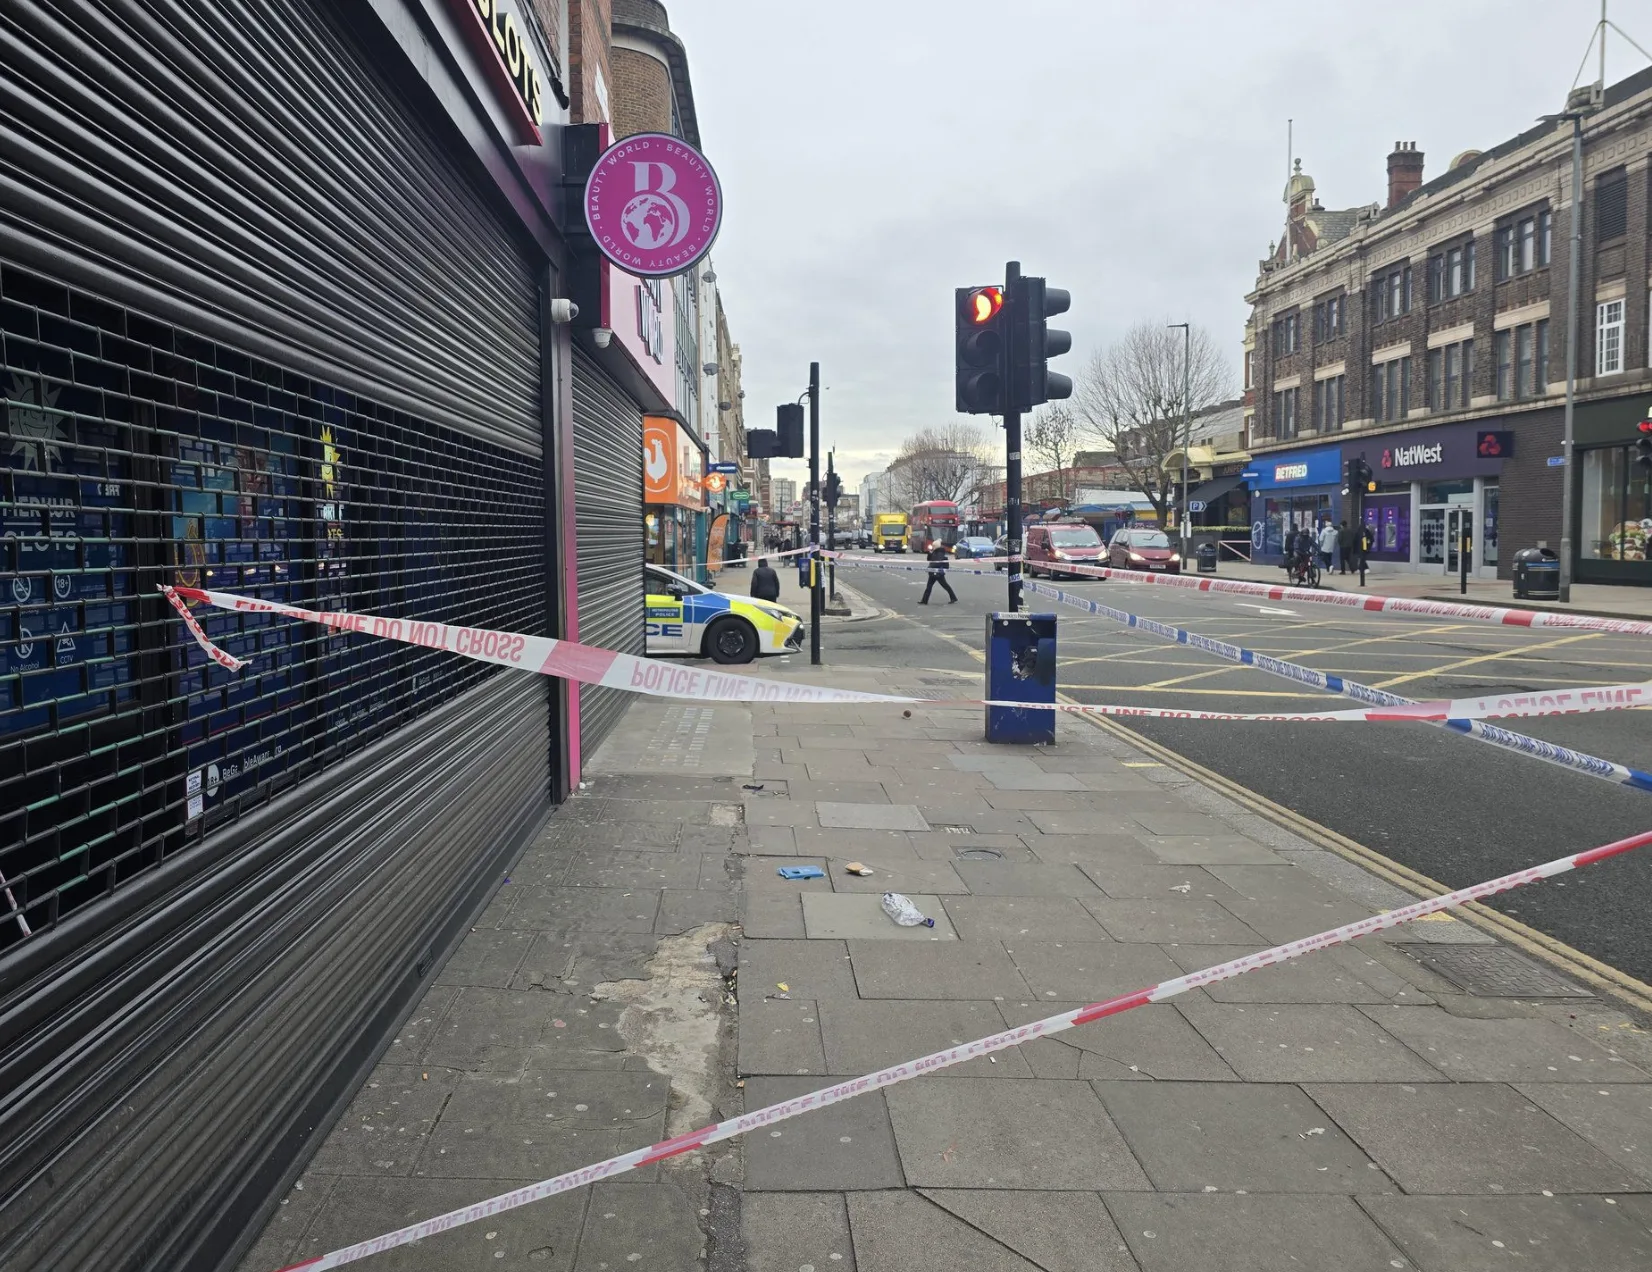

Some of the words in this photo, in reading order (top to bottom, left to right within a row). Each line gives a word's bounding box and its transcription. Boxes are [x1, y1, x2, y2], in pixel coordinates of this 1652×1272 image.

[592, 168, 607, 221] BEAUTY
[606, 140, 650, 167] WORLD
[666, 144, 708, 180] BEAUTY
[702, 186, 714, 233] WORLD
[602, 235, 642, 266] WORLD
[649, 244, 697, 268] BEAUTY
[1395, 442, 1442, 467] NatWest
[1275, 464, 1308, 480] BETFRED
[60, 654, 74, 664] CCTV
